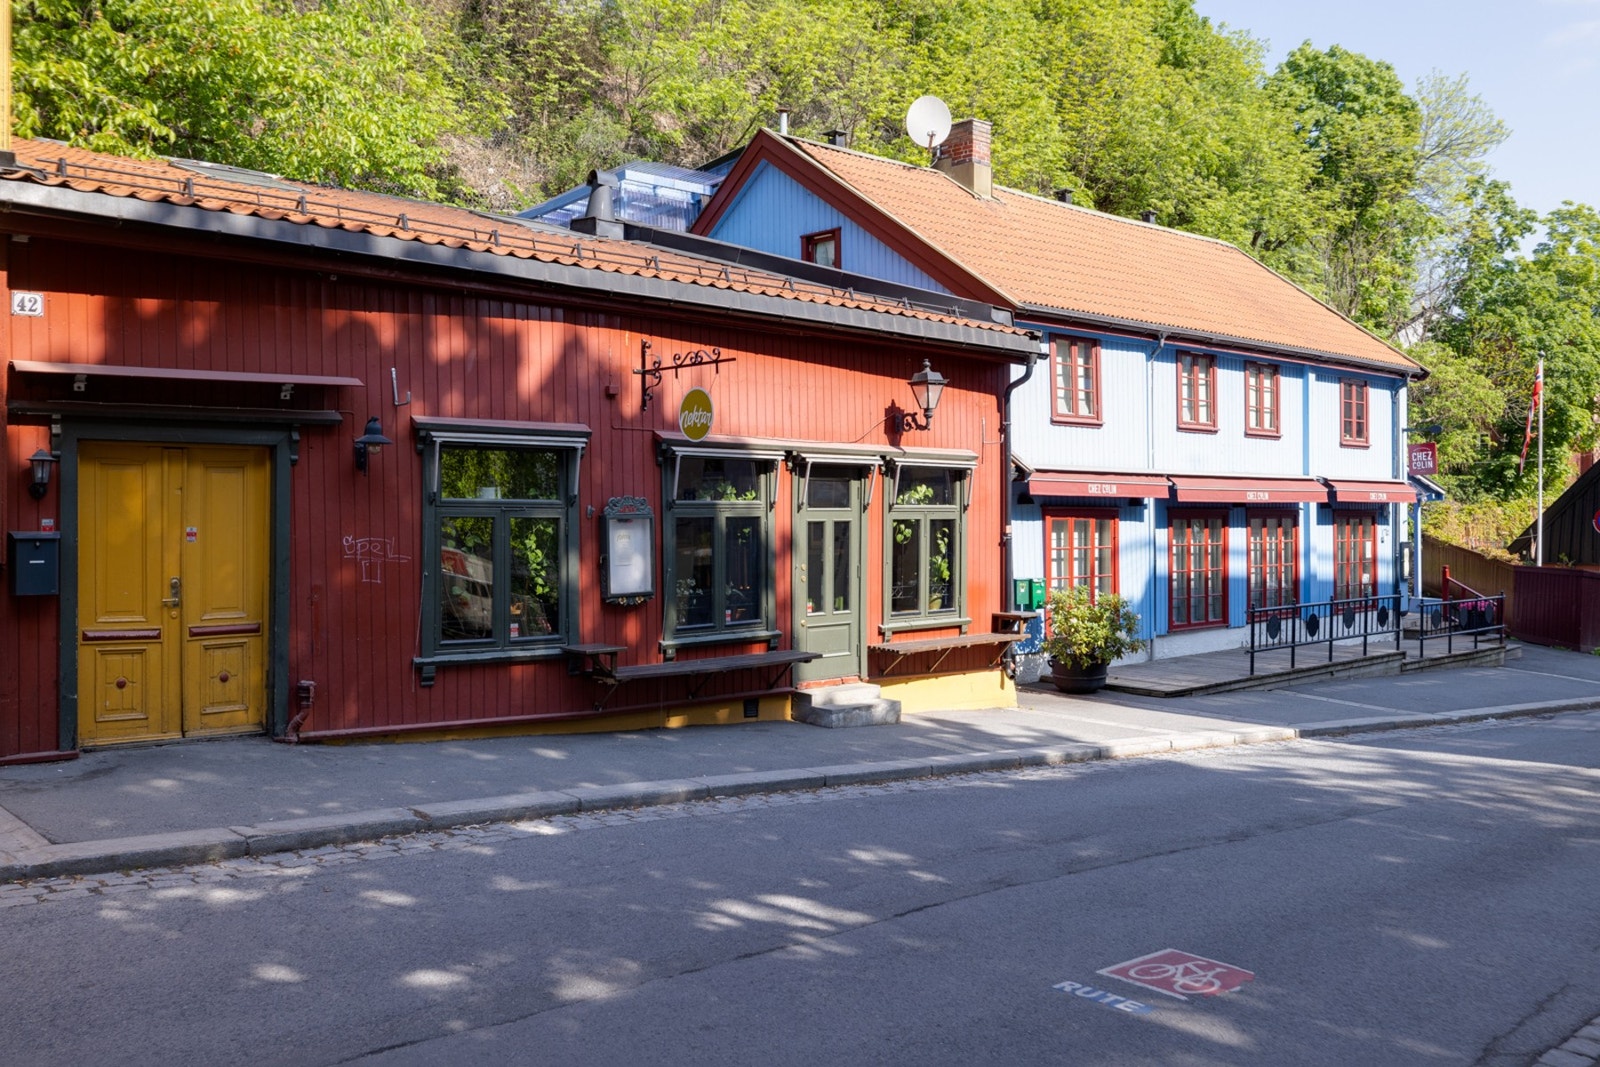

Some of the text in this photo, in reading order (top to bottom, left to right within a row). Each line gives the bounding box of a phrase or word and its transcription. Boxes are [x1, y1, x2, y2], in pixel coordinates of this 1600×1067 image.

[16, 296, 38, 312] 42
[1411, 451, 1433, 462] CHEZ
[1412, 460, 1434, 470] COLIN
[1052, 980, 1145, 1012] RUTE
